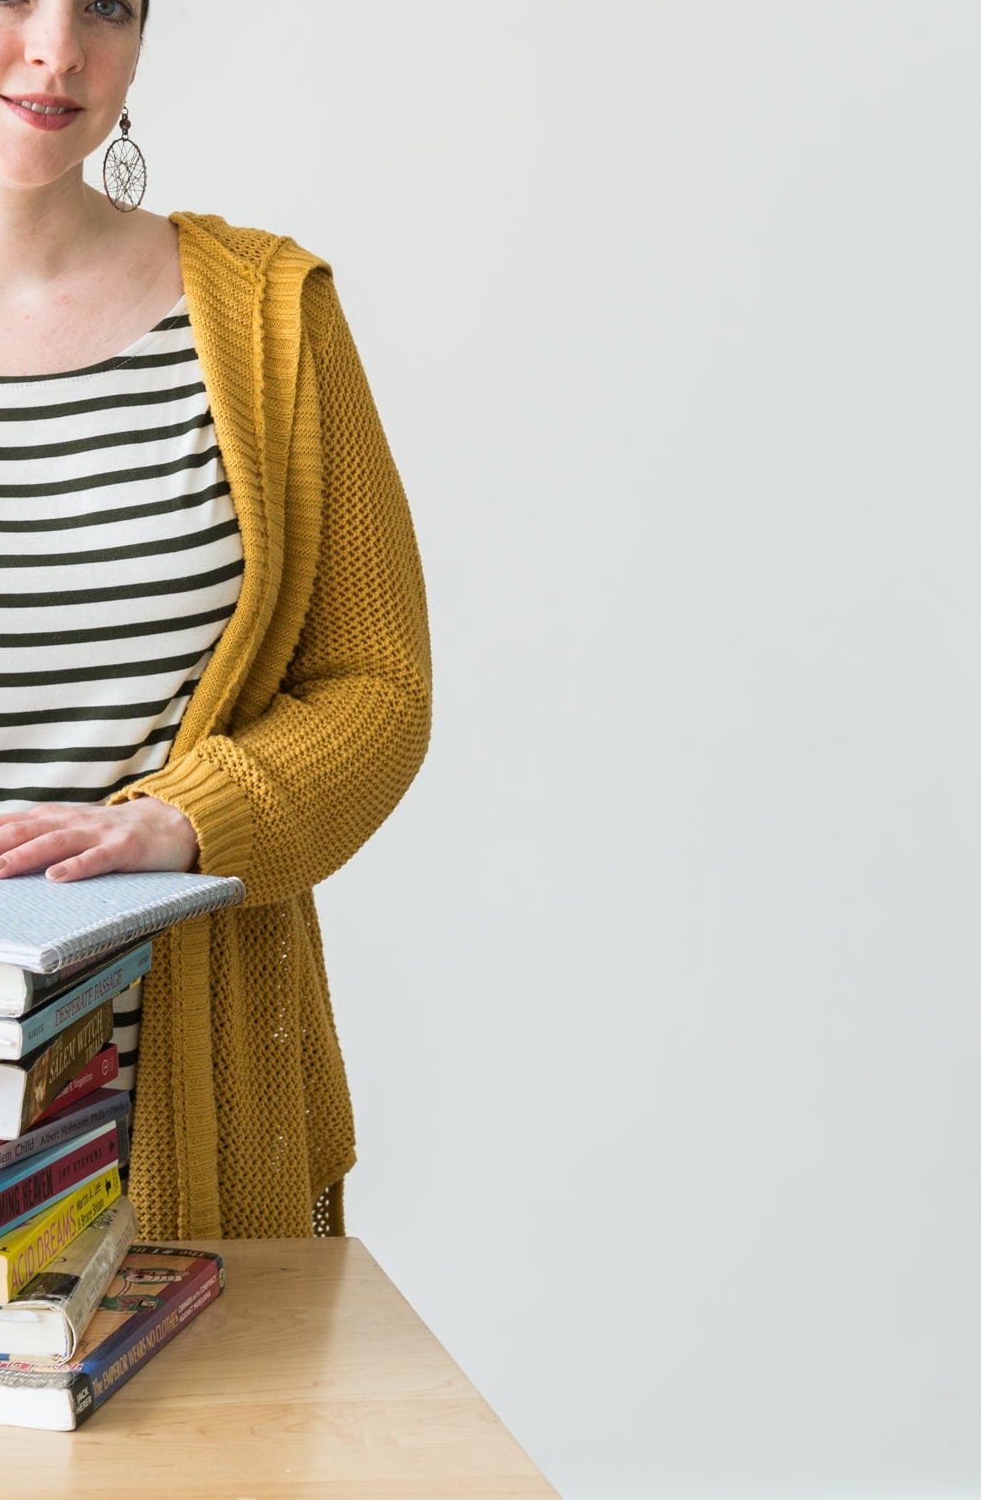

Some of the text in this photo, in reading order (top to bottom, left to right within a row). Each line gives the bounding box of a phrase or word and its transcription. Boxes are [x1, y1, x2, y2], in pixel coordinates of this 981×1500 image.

[55, 988, 93, 1027] DESPERATE
[94, 968, 123, 1000] PASSAGE
[49, 1037, 75, 1084] SALEM
[77, 1008, 103, 1053] WITCH
[14, 1138, 35, 1157] Child
[40, 1130, 60, 1147] Albert
[22, 1168, 53, 1210] HEAVEN
[73, 1148, 103, 1173] STEVENS
[10, 1244, 35, 1297] ACID
[37, 1204, 76, 1269] DREAMS
[92, 1377, 103, 1398] The
[102, 1354, 128, 1390] EMPEROR
[127, 1337, 146, 1368] WEARS
[146, 1329, 156, 1350] NO
[155, 1309, 179, 1342] CLOTHES
[76, 1386, 90, 1404] JACK
